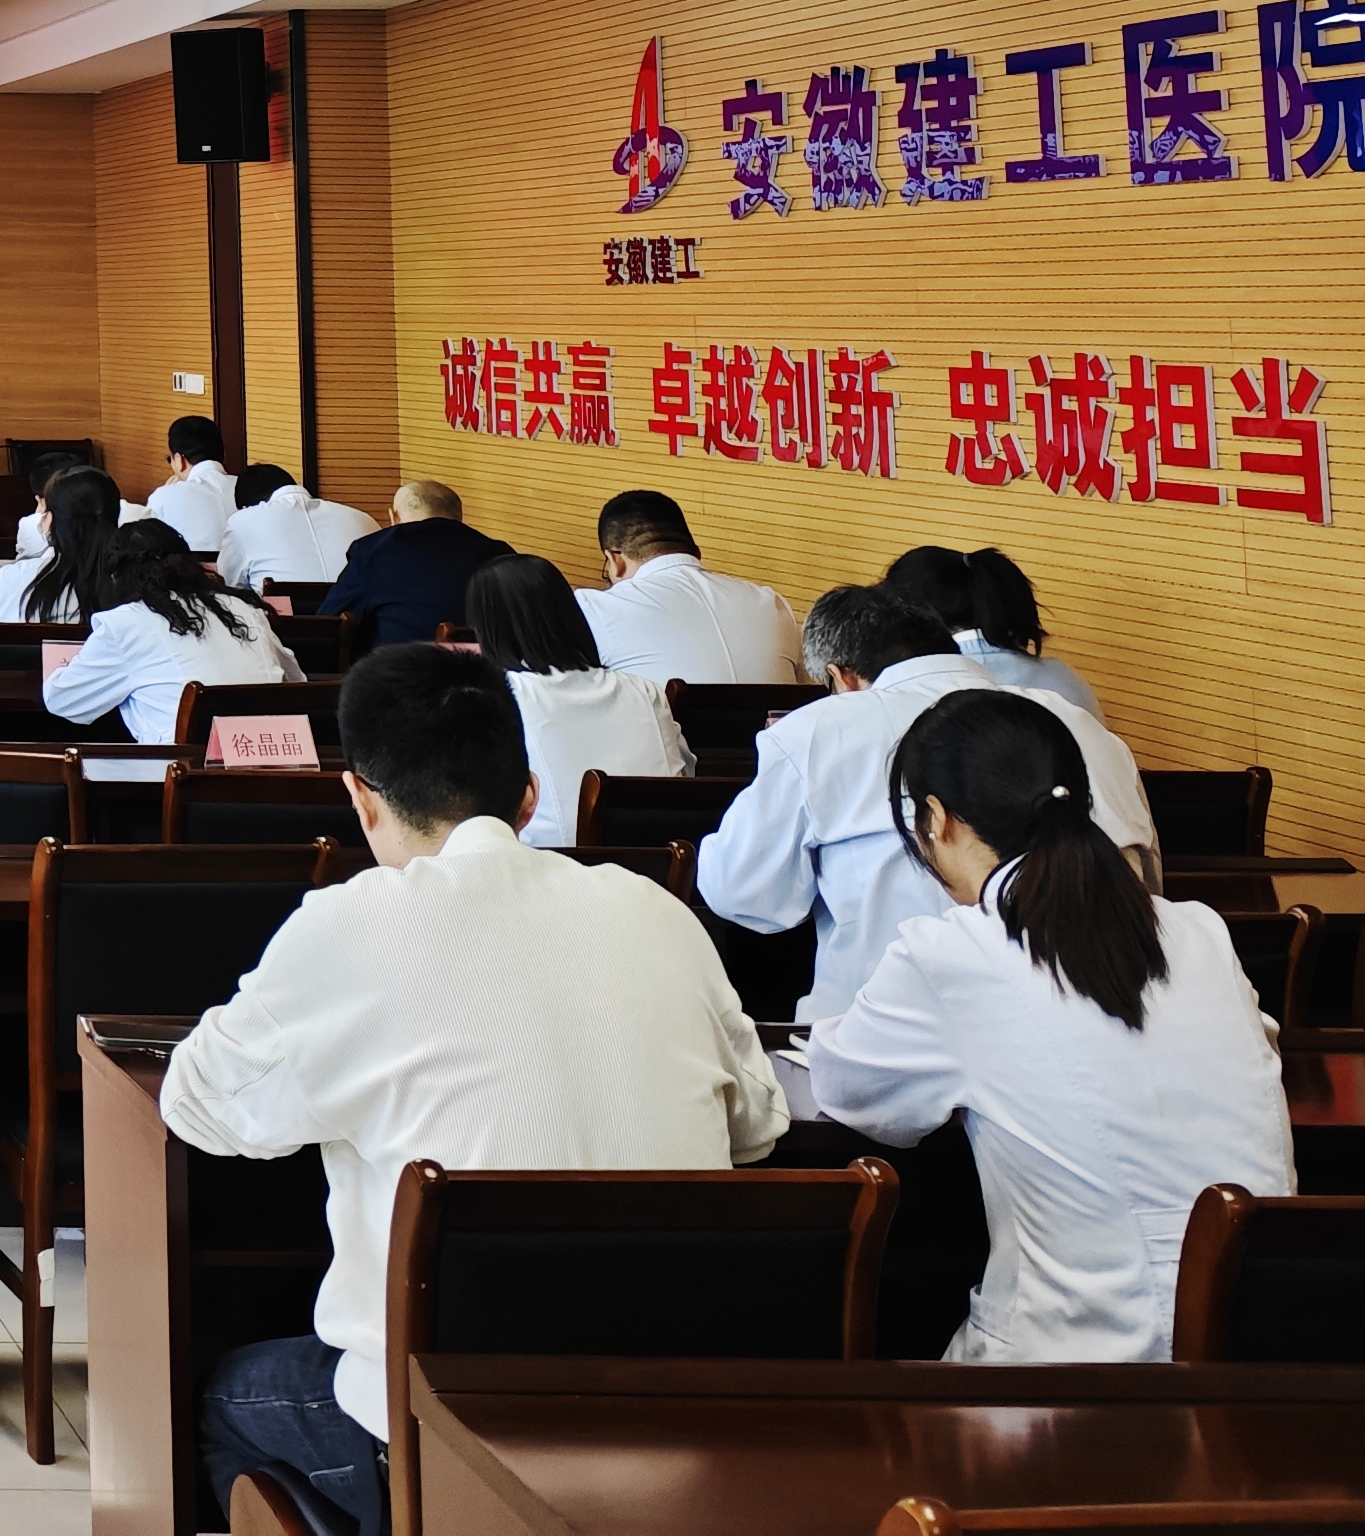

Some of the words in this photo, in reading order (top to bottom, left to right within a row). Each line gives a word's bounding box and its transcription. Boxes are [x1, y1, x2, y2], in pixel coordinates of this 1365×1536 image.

[602, 235, 705, 286] 安徽建工
[440, 336, 620, 449] 诚信共赢
[647, 341, 901, 480] 卓越创新
[944, 350, 1333, 526] 忠诚担当
[231, 732, 303, 758] 徐晶晶
